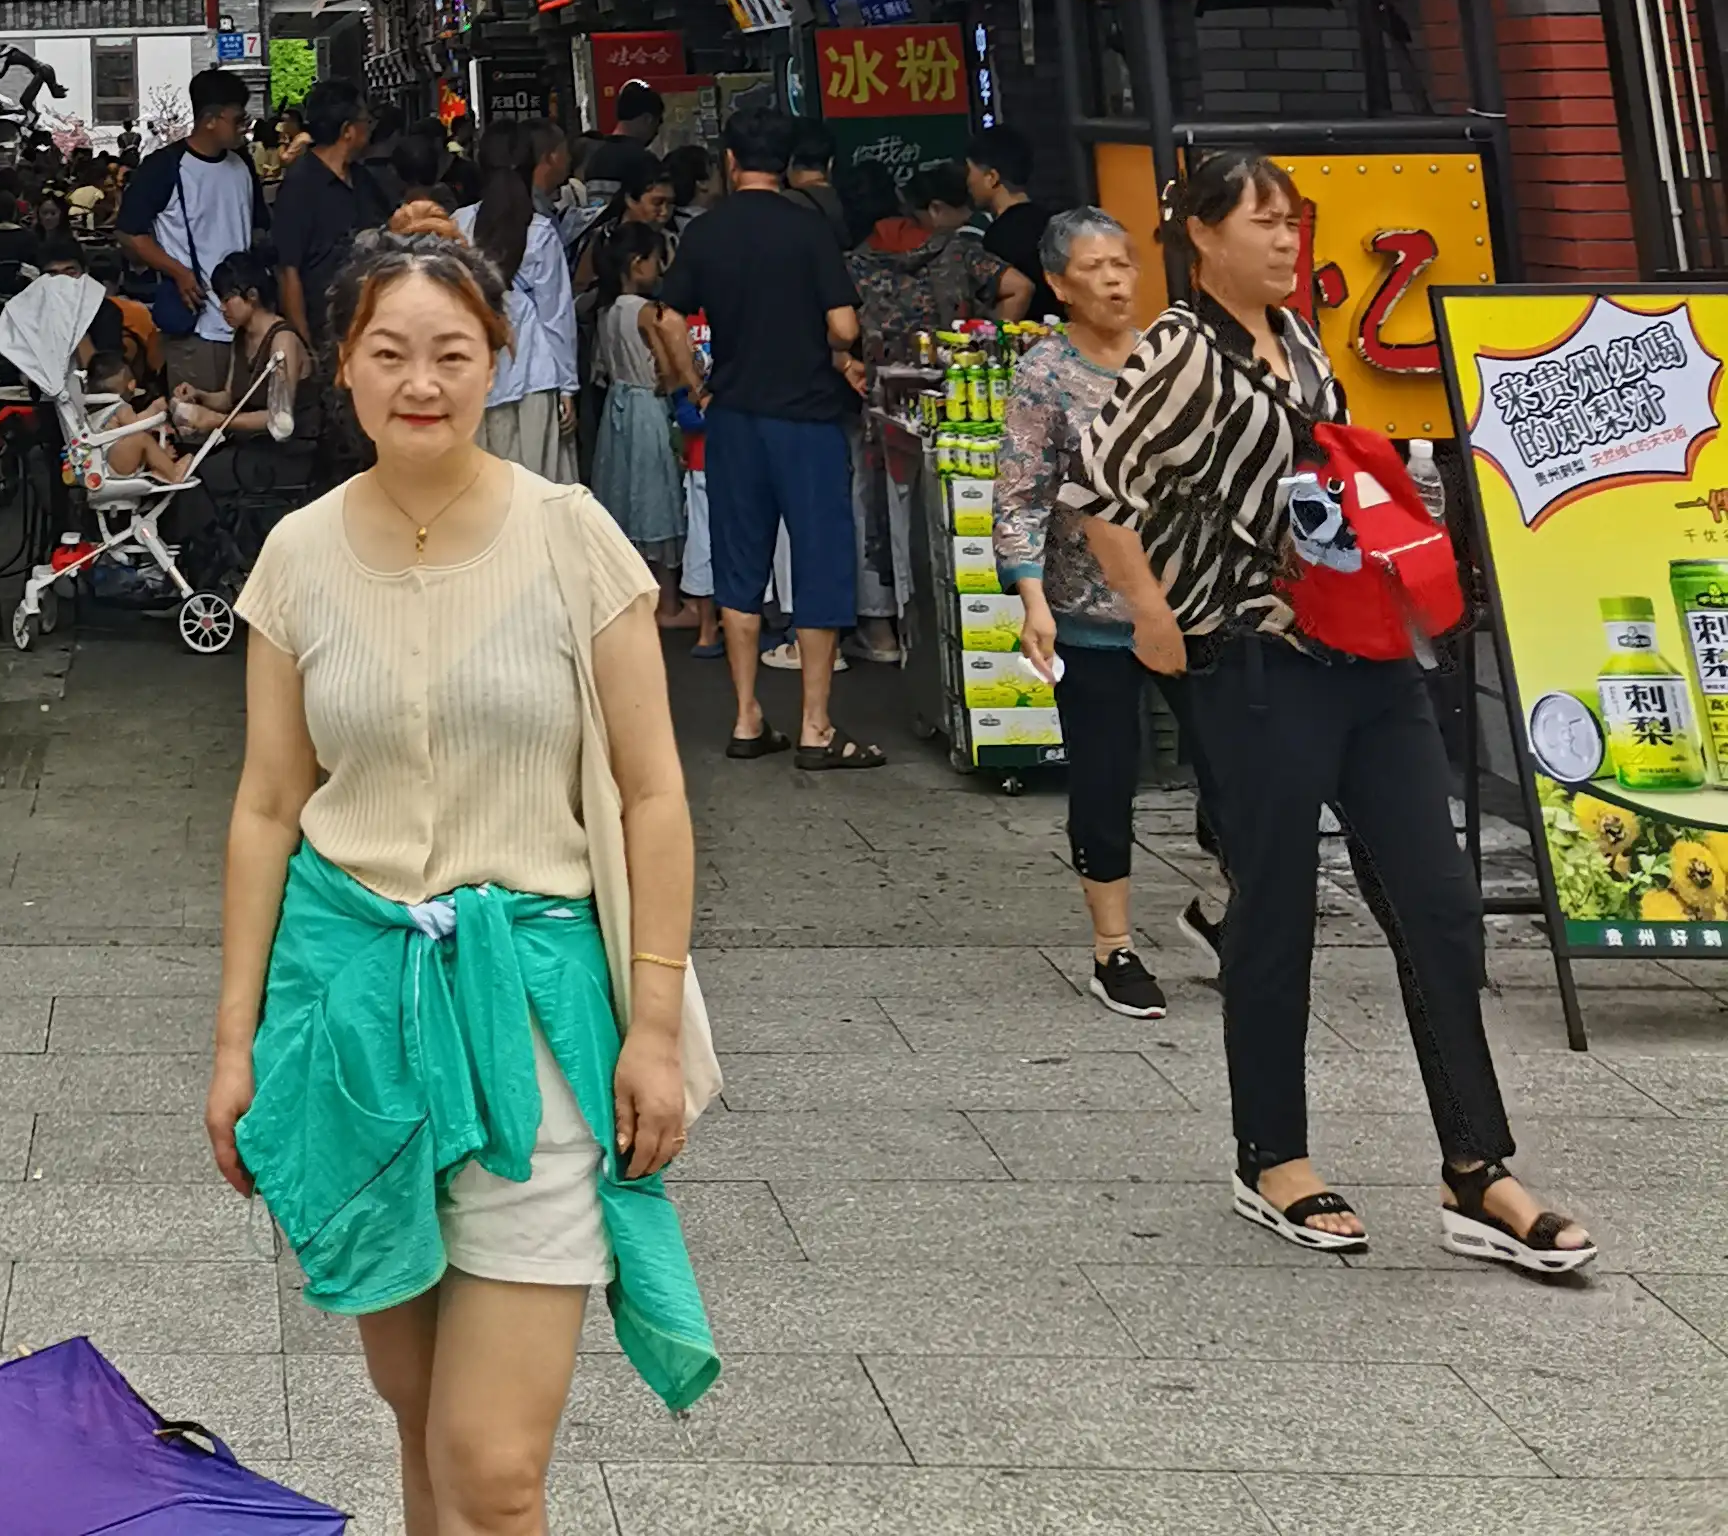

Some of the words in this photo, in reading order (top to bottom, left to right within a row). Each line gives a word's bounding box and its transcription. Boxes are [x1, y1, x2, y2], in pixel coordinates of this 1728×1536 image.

[247, 36, 257, 54] 7
[824, 35, 961, 105] 冰粉
[1491, 321, 1688, 424] 来贵州必喝
[1511, 378, 1666, 468] 的刺梨汁
[1622, 683, 1674, 746] 刺梨
